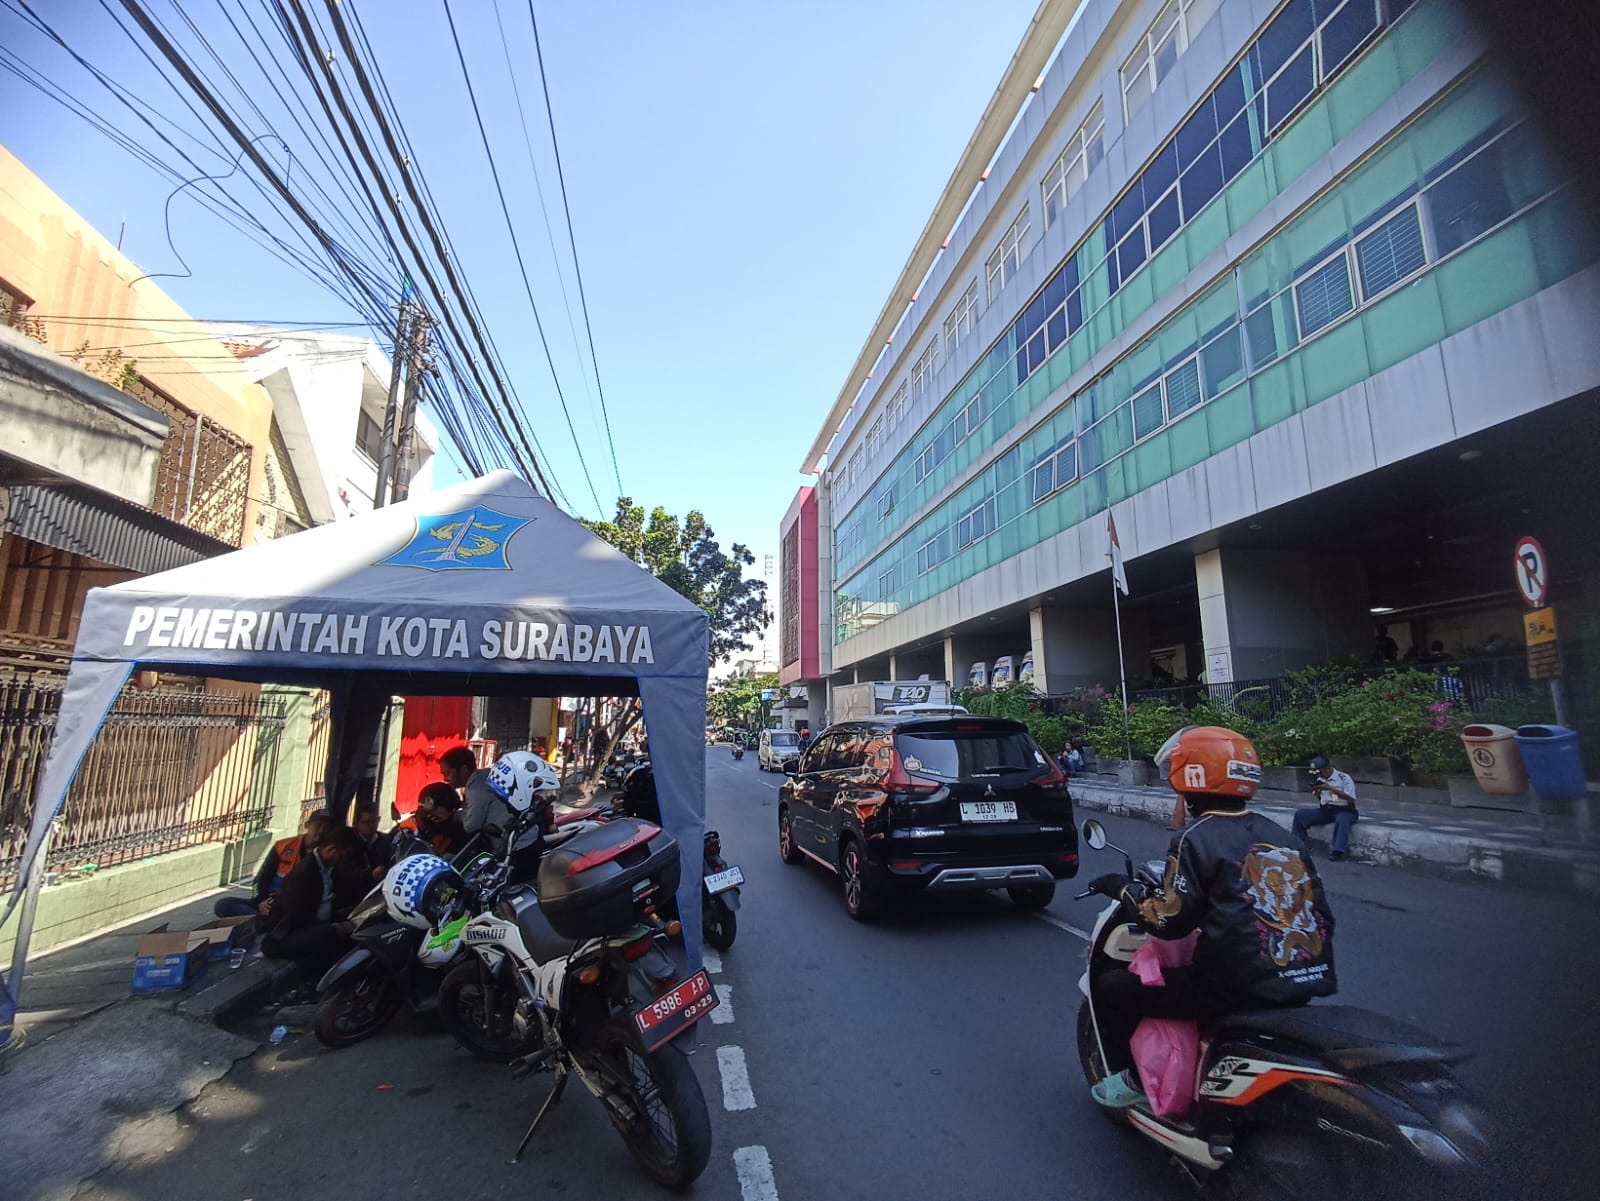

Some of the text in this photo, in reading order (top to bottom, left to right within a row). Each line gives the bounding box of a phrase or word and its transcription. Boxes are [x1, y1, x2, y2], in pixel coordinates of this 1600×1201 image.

[123, 605, 655, 665] PEMERINTAH KOTA SURABAYA
[961, 802, 1015, 815] L 1039 HB
[639, 1014, 650, 1029] L
[652, 991, 682, 1019] 5986
